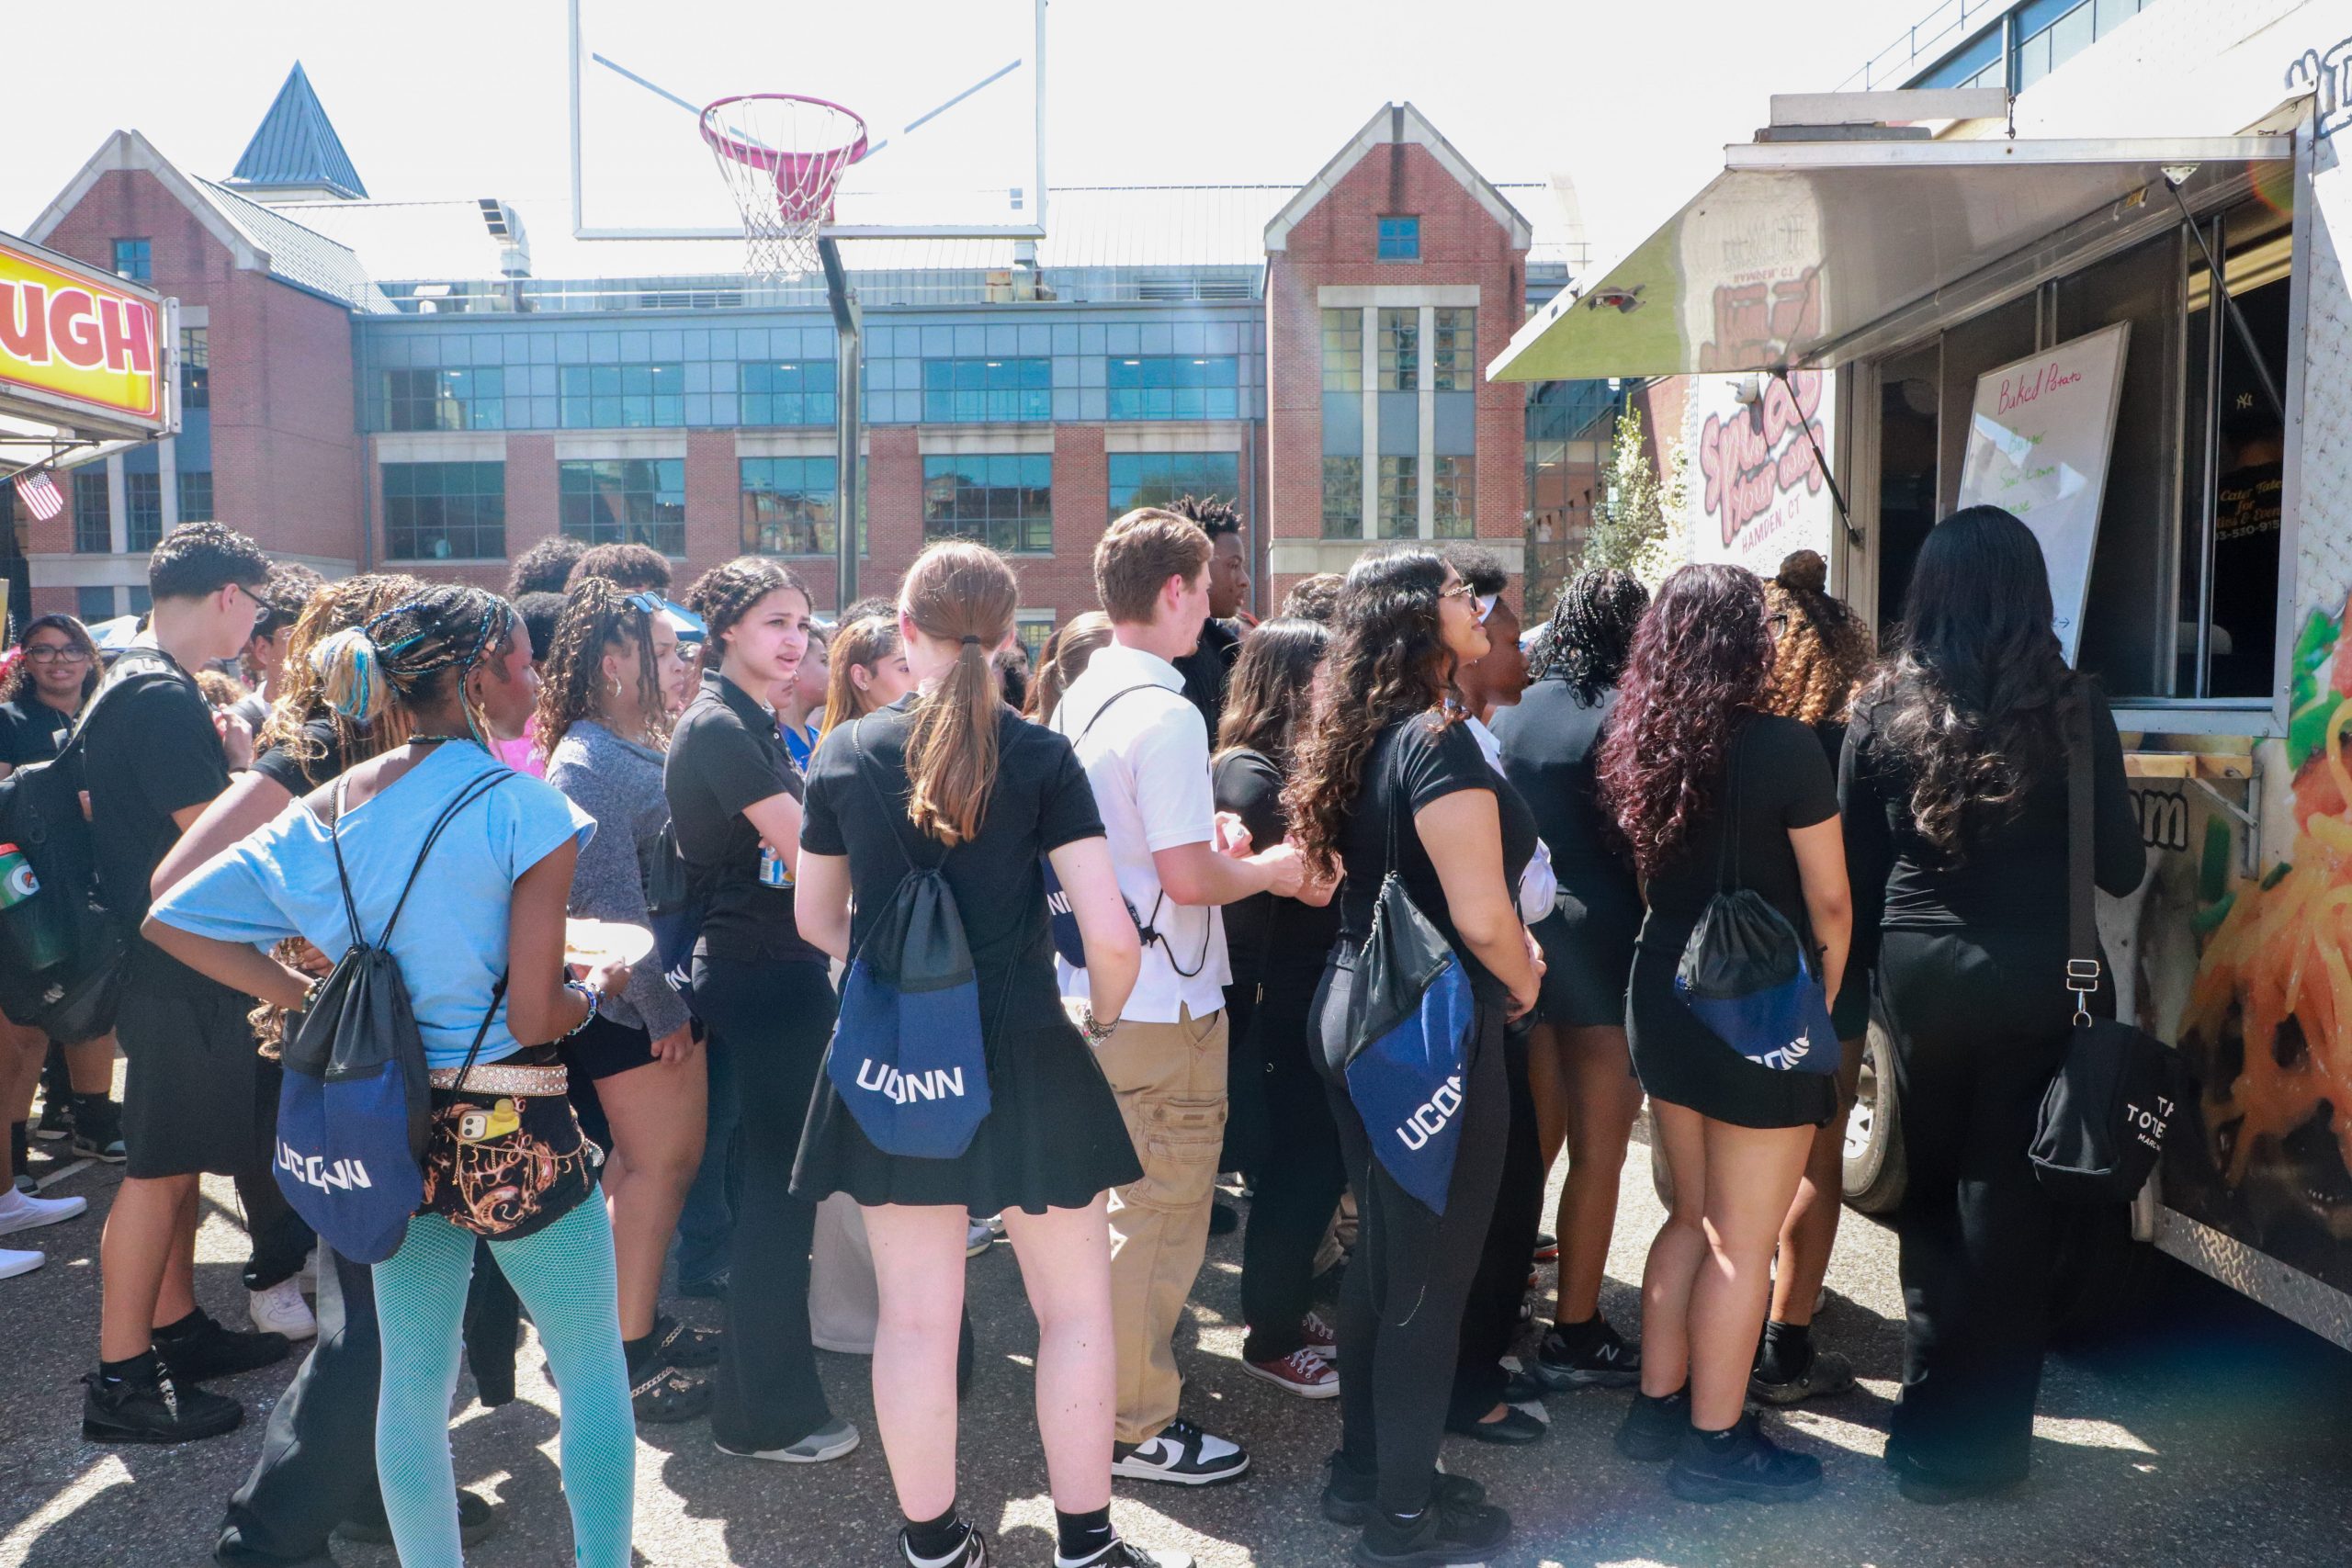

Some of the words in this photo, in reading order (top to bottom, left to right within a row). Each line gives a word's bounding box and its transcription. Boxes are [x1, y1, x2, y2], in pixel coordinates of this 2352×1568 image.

[0, 279, 154, 376] UGH
[2045, 363, 2082, 394] Potato
[1789, 493, 1801, 519] CT
[2127, 1103, 2166, 1139] TOTE
